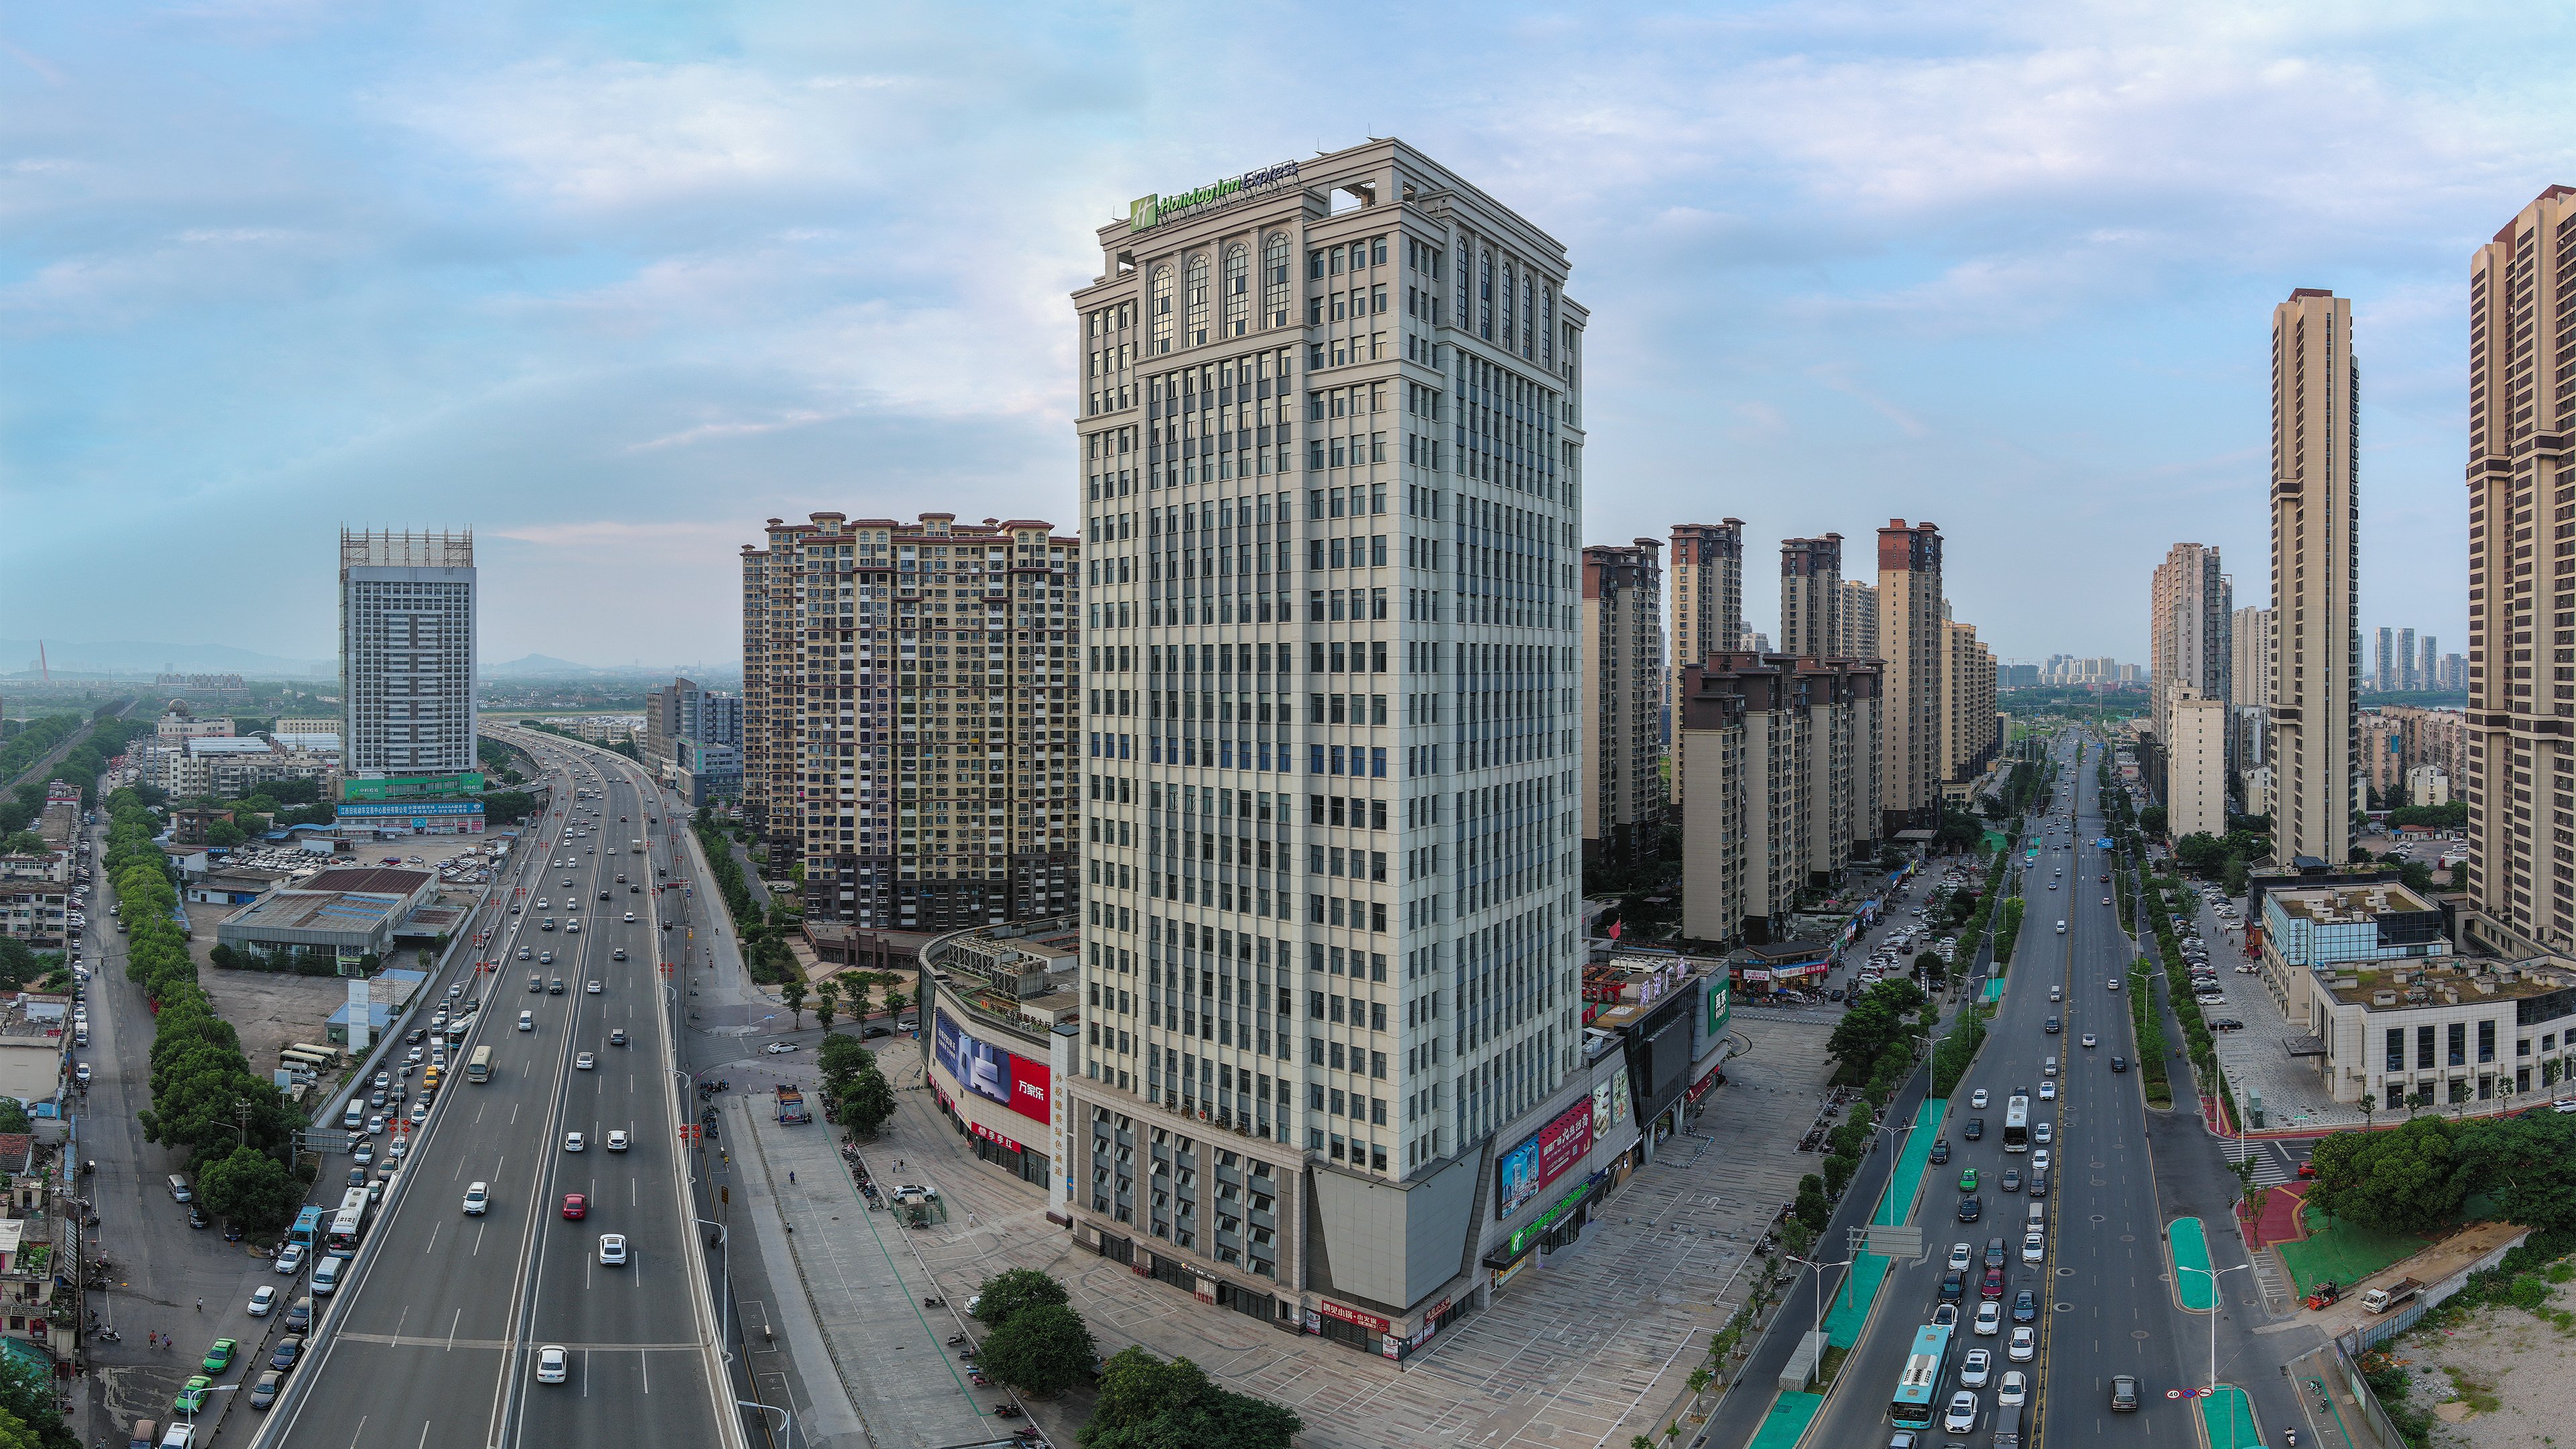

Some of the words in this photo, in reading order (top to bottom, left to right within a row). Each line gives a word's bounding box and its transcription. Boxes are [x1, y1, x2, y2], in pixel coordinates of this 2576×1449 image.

[1160, 188, 1216, 215] Holiday
[1217, 178, 1241, 197] Inn
[1242, 161, 1299, 190] Express
[1715, 1004, 1726, 1020] MART
[1018, 1080, 1044, 1101] 万家乐
[988, 1130, 1013, 1149] 季季红
